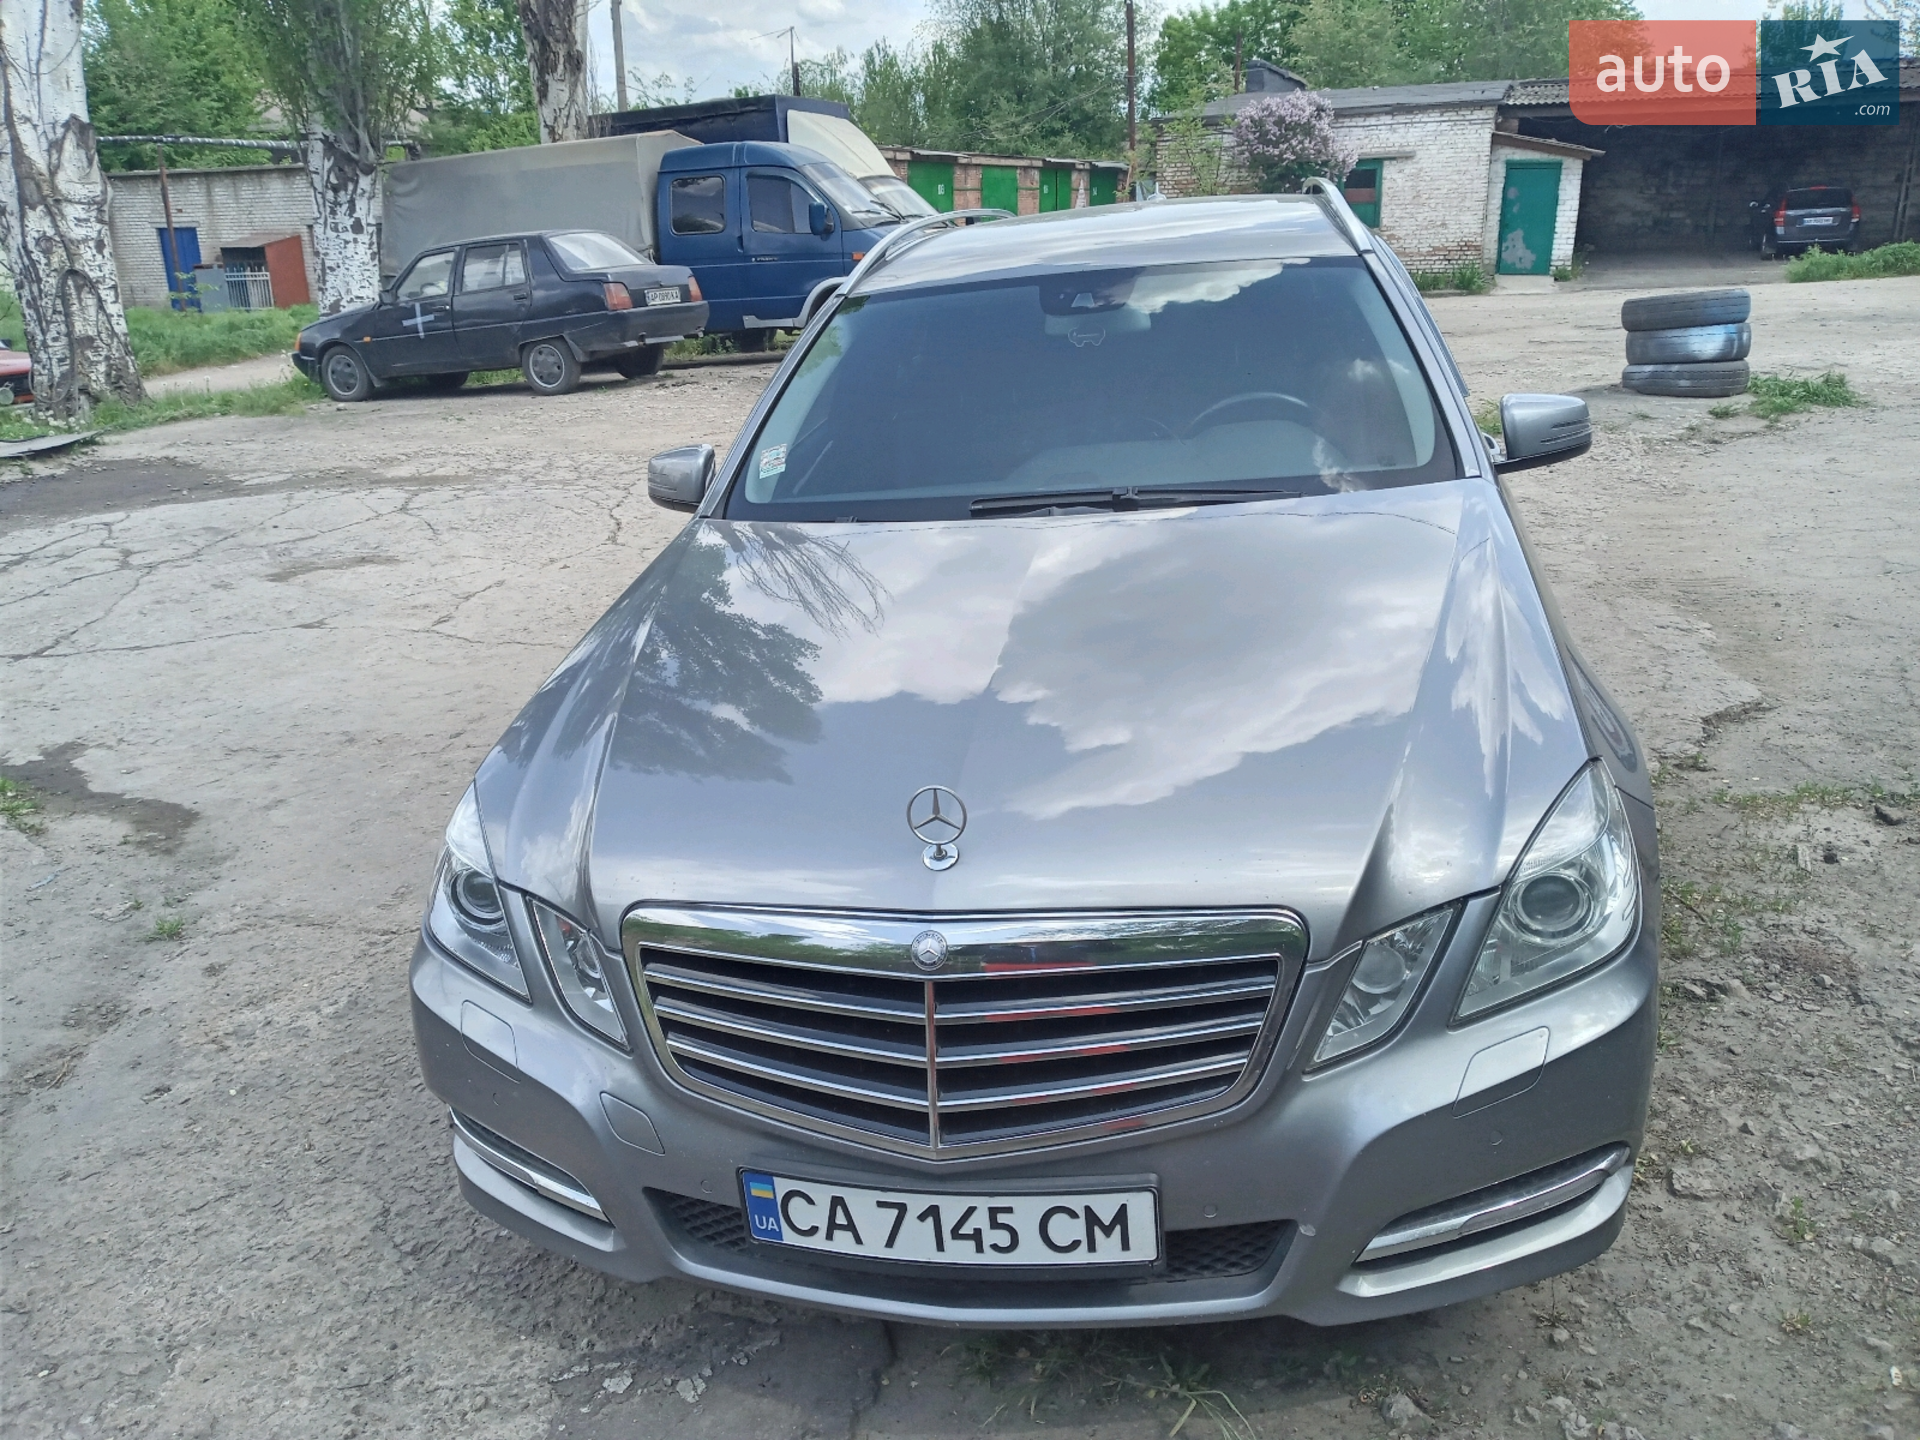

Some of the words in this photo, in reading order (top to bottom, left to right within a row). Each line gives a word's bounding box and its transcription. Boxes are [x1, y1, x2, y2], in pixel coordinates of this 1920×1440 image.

[754, 1214, 780, 1232] UA
[780, 1189, 863, 1246] CA
[876, 1200, 1020, 1254] 7145
[1038, 1203, 1131, 1254] CM
